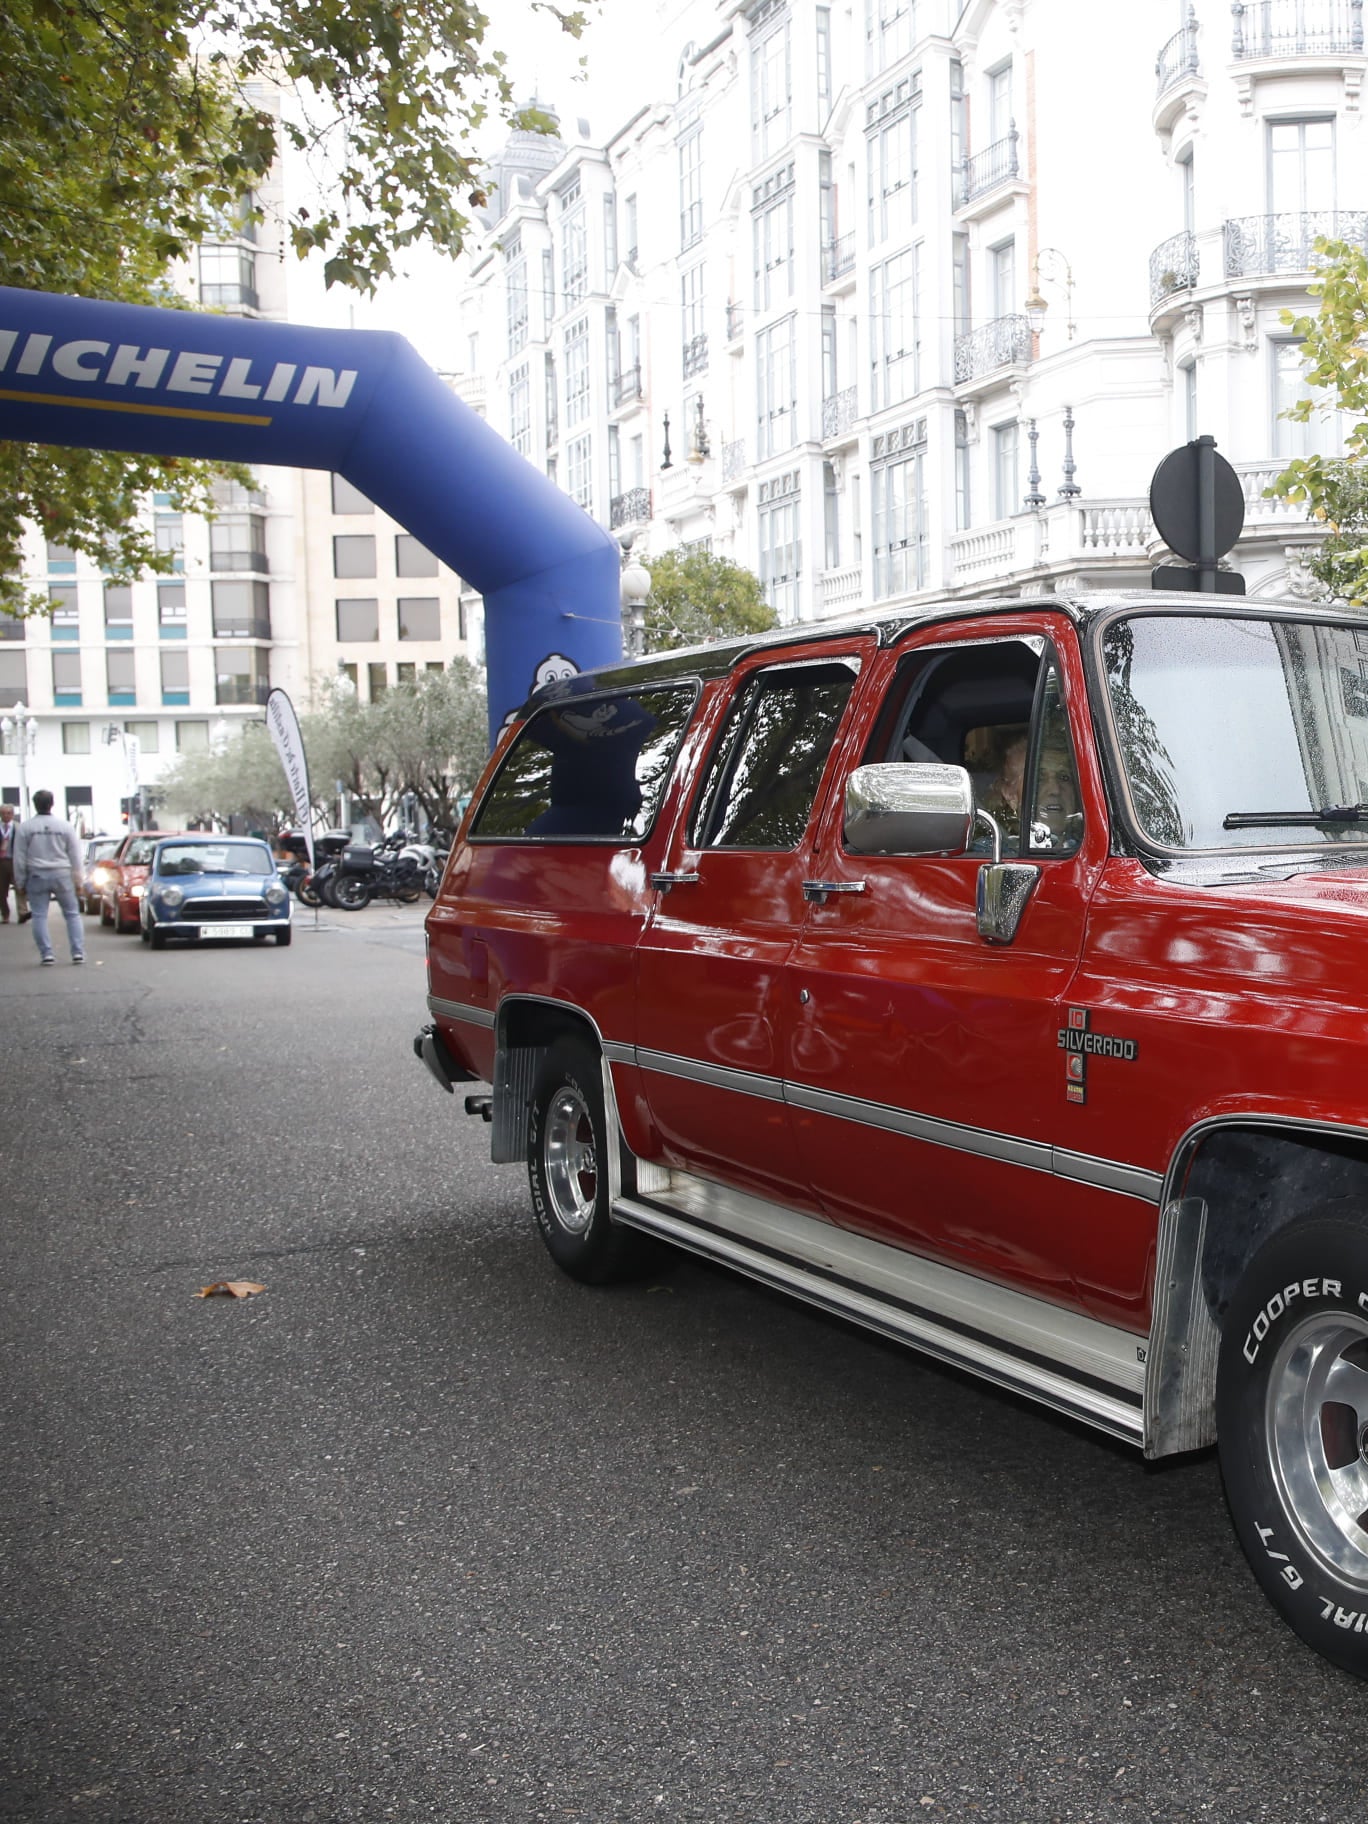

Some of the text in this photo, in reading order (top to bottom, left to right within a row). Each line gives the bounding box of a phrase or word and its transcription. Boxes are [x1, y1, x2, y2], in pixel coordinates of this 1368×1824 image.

[0, 330, 358, 408] ICHELIN
[1057, 1029, 1134, 1060] SILVERADO
[1243, 1278, 1343, 1364] COOPER
[1254, 1521, 1304, 1590] G/T
